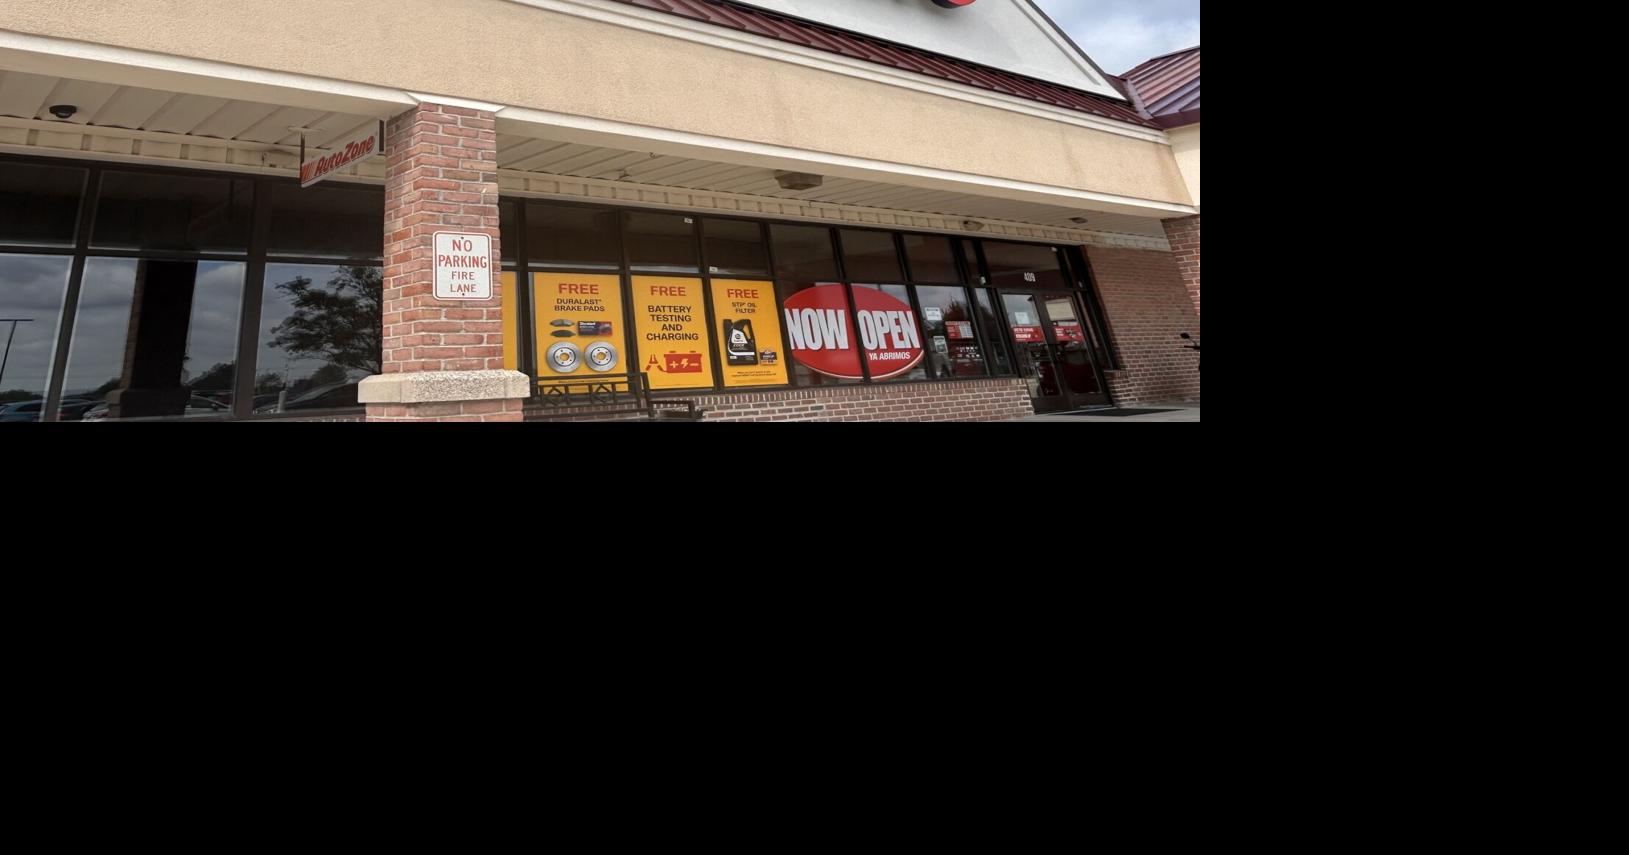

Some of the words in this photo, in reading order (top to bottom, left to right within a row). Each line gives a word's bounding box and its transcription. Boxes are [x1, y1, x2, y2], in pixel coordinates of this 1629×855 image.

[315, 135, 375, 176] AutoZone
[452, 239, 472, 252] NO
[438, 255, 487, 269] PARKING
[451, 272, 475, 281] FIRE
[1023, 272, 1036, 282] 409
[450, 283, 477, 293] LANE
[558, 283, 599, 295] FREE
[650, 286, 686, 297] FREE
[727, 289, 759, 299] FREE
[648, 305, 692, 313] BATTERY
[650, 314, 692, 322] TESTING
[784, 308, 849, 351] NOW
[857, 310, 920, 351] OPEN
[646, 333, 699, 341] CHARGING
[869, 352, 878, 361] YA
[879, 351, 911, 360] ABRIMOS
